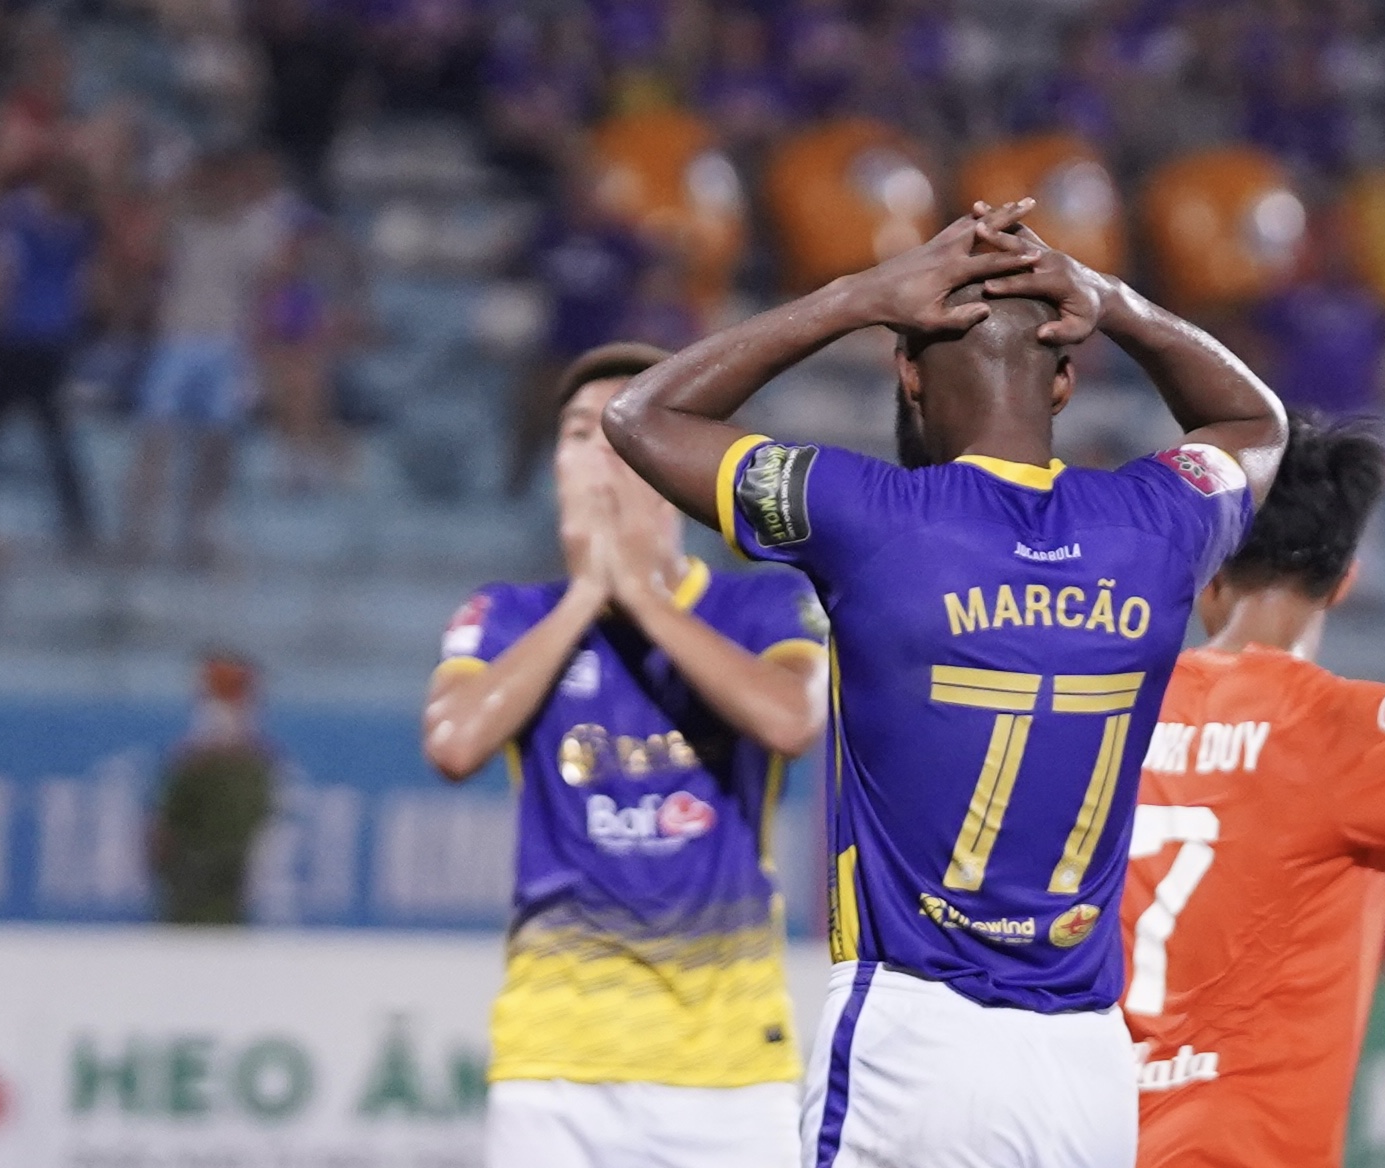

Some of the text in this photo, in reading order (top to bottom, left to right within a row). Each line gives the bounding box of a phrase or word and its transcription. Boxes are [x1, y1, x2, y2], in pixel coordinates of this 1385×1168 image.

[943, 577, 1151, 639] MARCÃO
[930, 664, 1147, 893] 77
[1195, 720, 1271, 773] DUY
[1123, 803, 1220, 1017] 7
